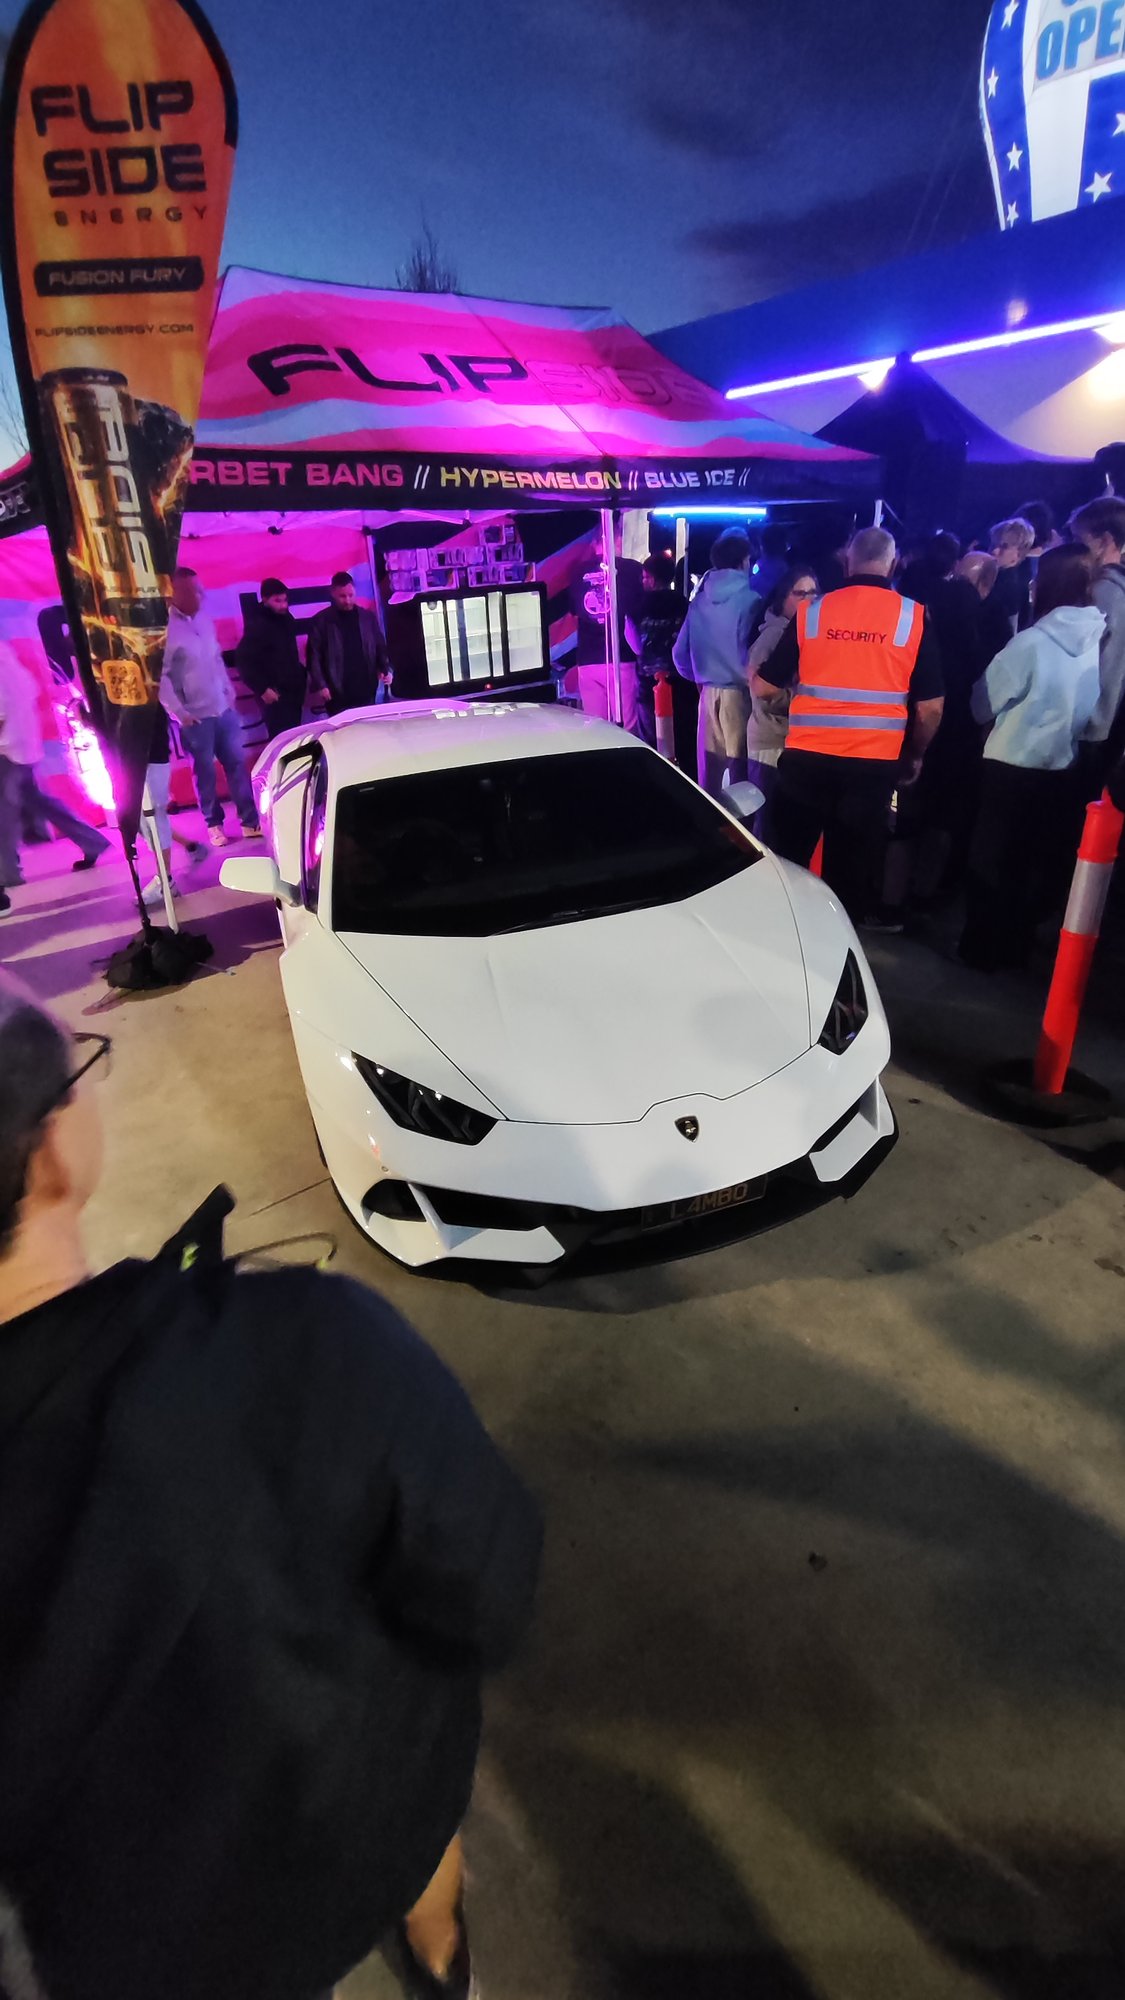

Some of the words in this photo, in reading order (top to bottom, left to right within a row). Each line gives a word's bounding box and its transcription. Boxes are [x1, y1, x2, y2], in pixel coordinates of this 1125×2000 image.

[1036, 0, 1125, 80] OPE
[31, 81, 193, 136] FLIP
[43, 144, 207, 198] SIDE
[54, 206, 207, 226] ENERGY
[49, 270, 124, 286] FUSION
[130, 268, 186, 283] FURY
[306, 463, 404, 486] BANG
[440, 466, 622, 490] HYPERMELON
[644, 471, 700, 488] BLUE
[705, 469, 735, 486] ICE
[826, 628, 887, 645] SECURITY
